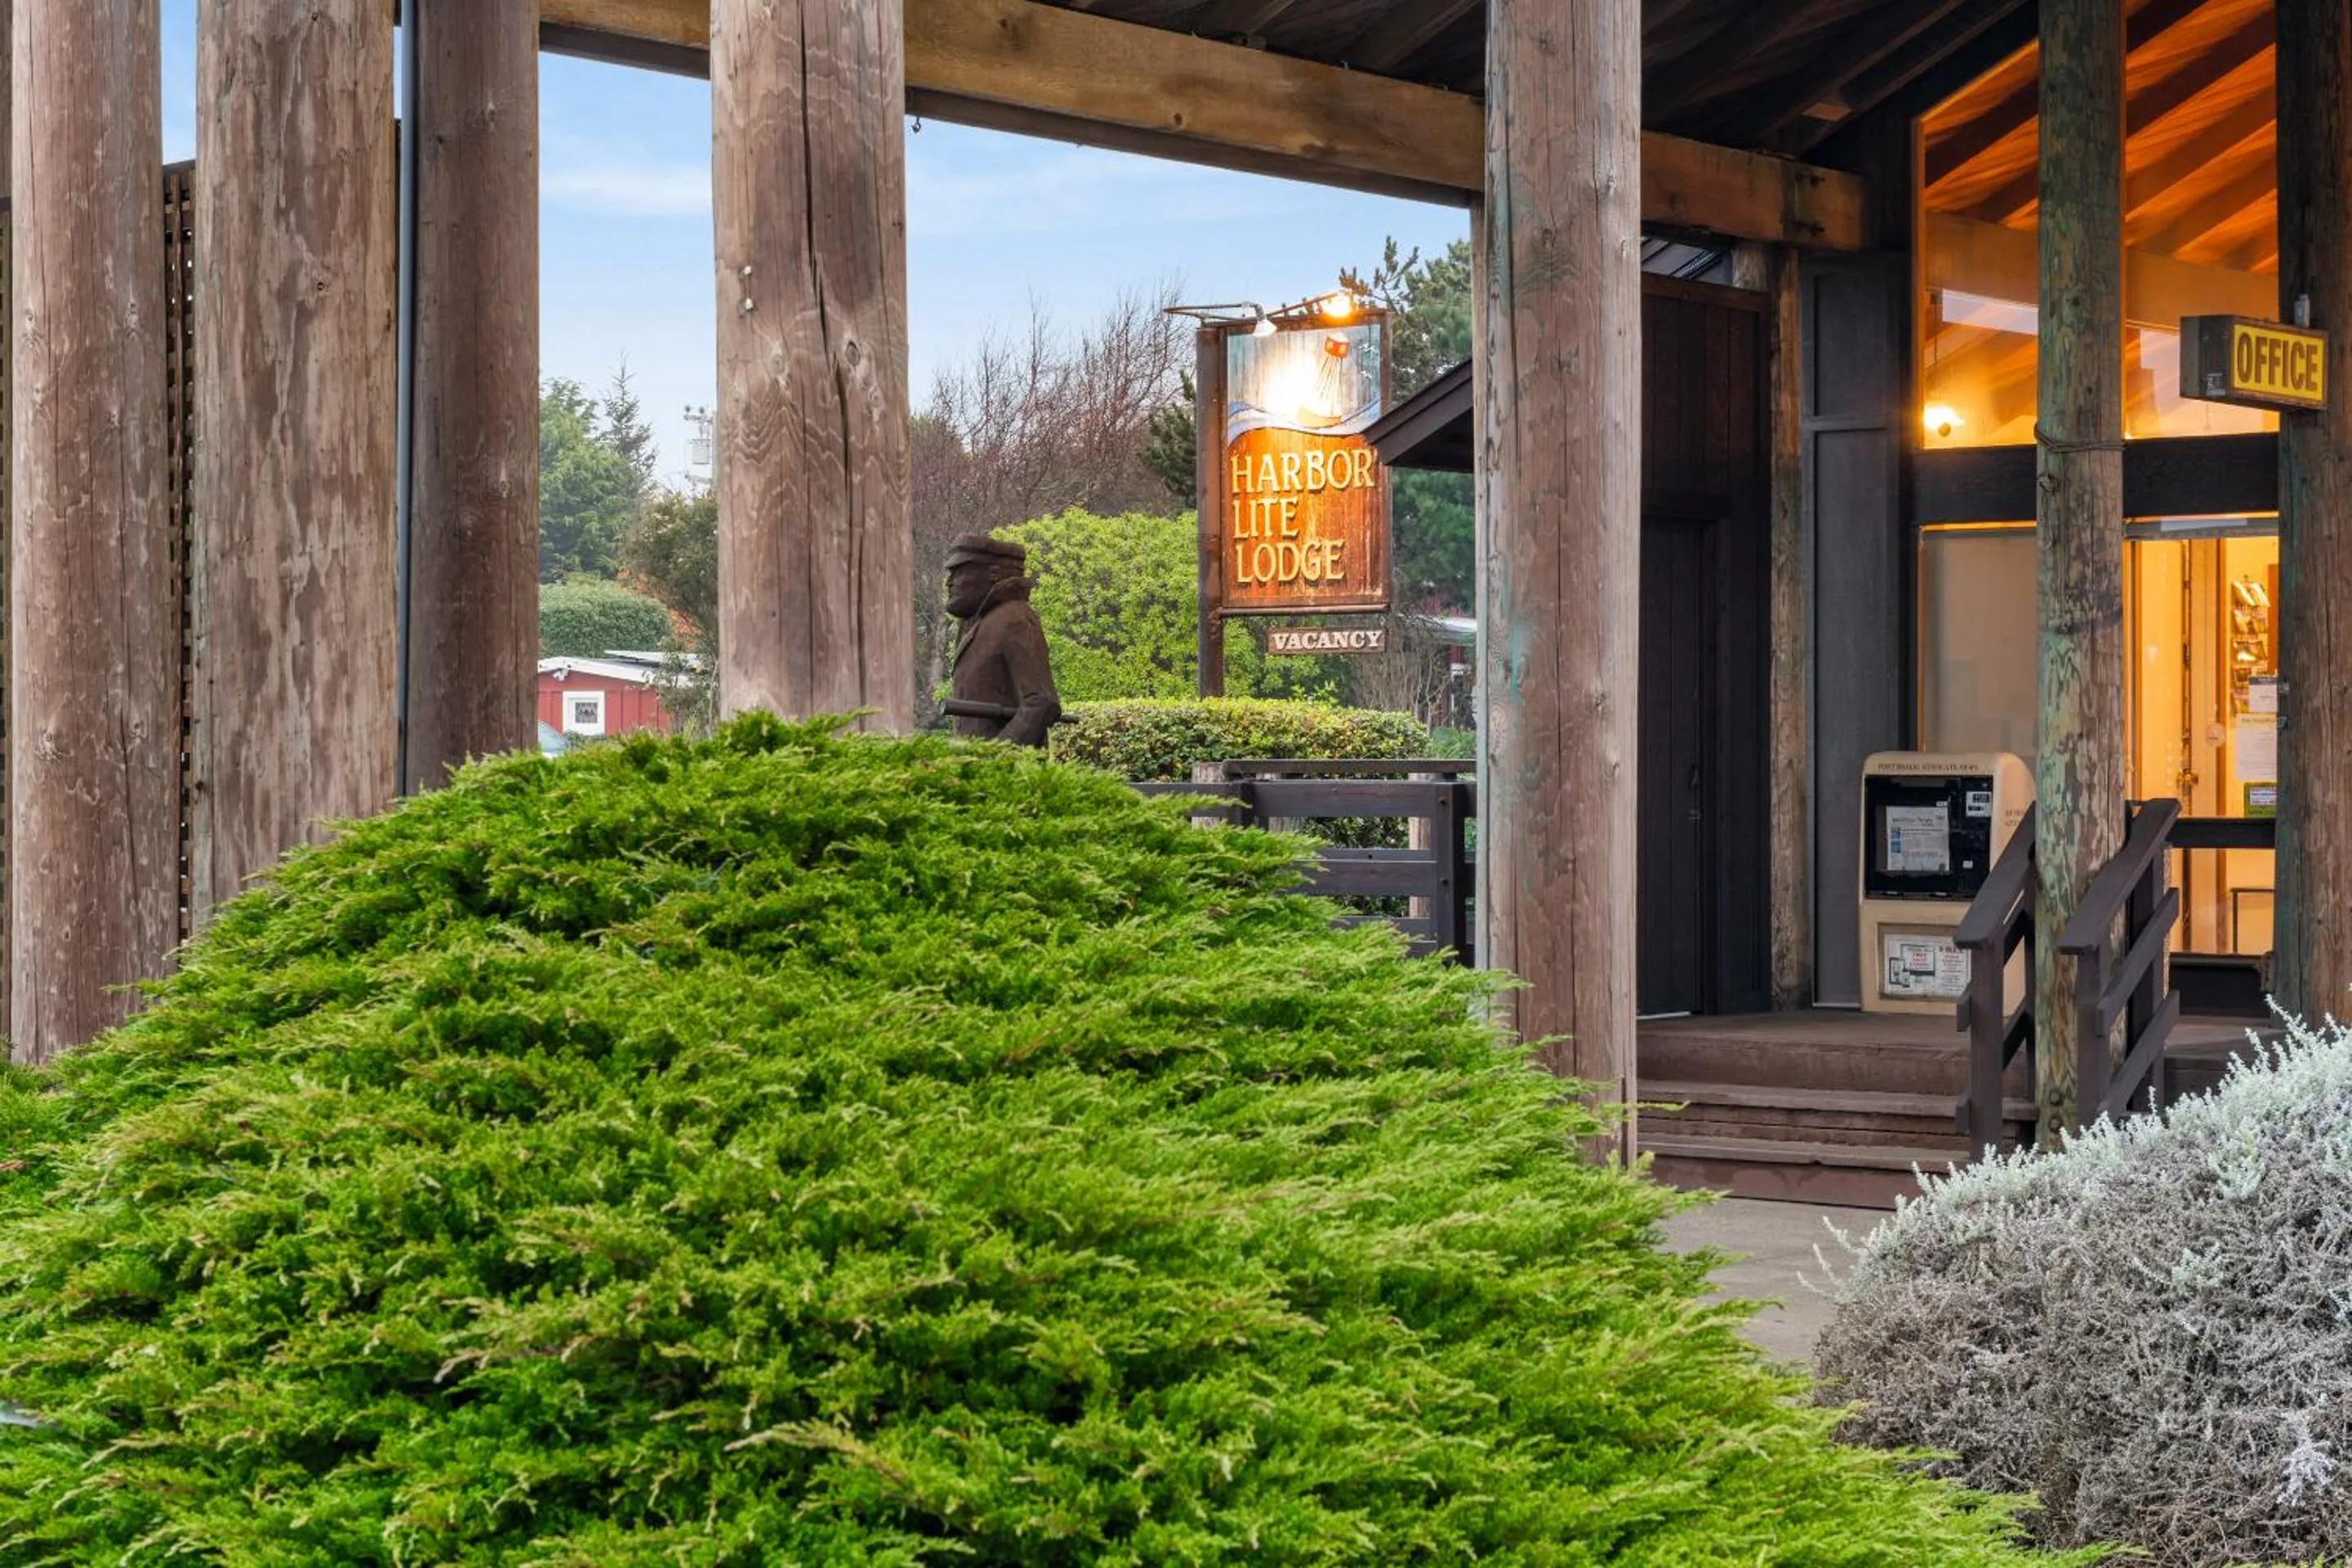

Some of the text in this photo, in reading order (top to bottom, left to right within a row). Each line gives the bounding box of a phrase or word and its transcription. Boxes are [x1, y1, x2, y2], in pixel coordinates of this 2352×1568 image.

[2237, 332, 2318, 391] OFFICE
[1231, 450, 1374, 492] HARBOR
[1233, 497, 1298, 538] LITE
[1236, 539, 1346, 582] LODGE
[1272, 630, 1382, 650] VACANCY
